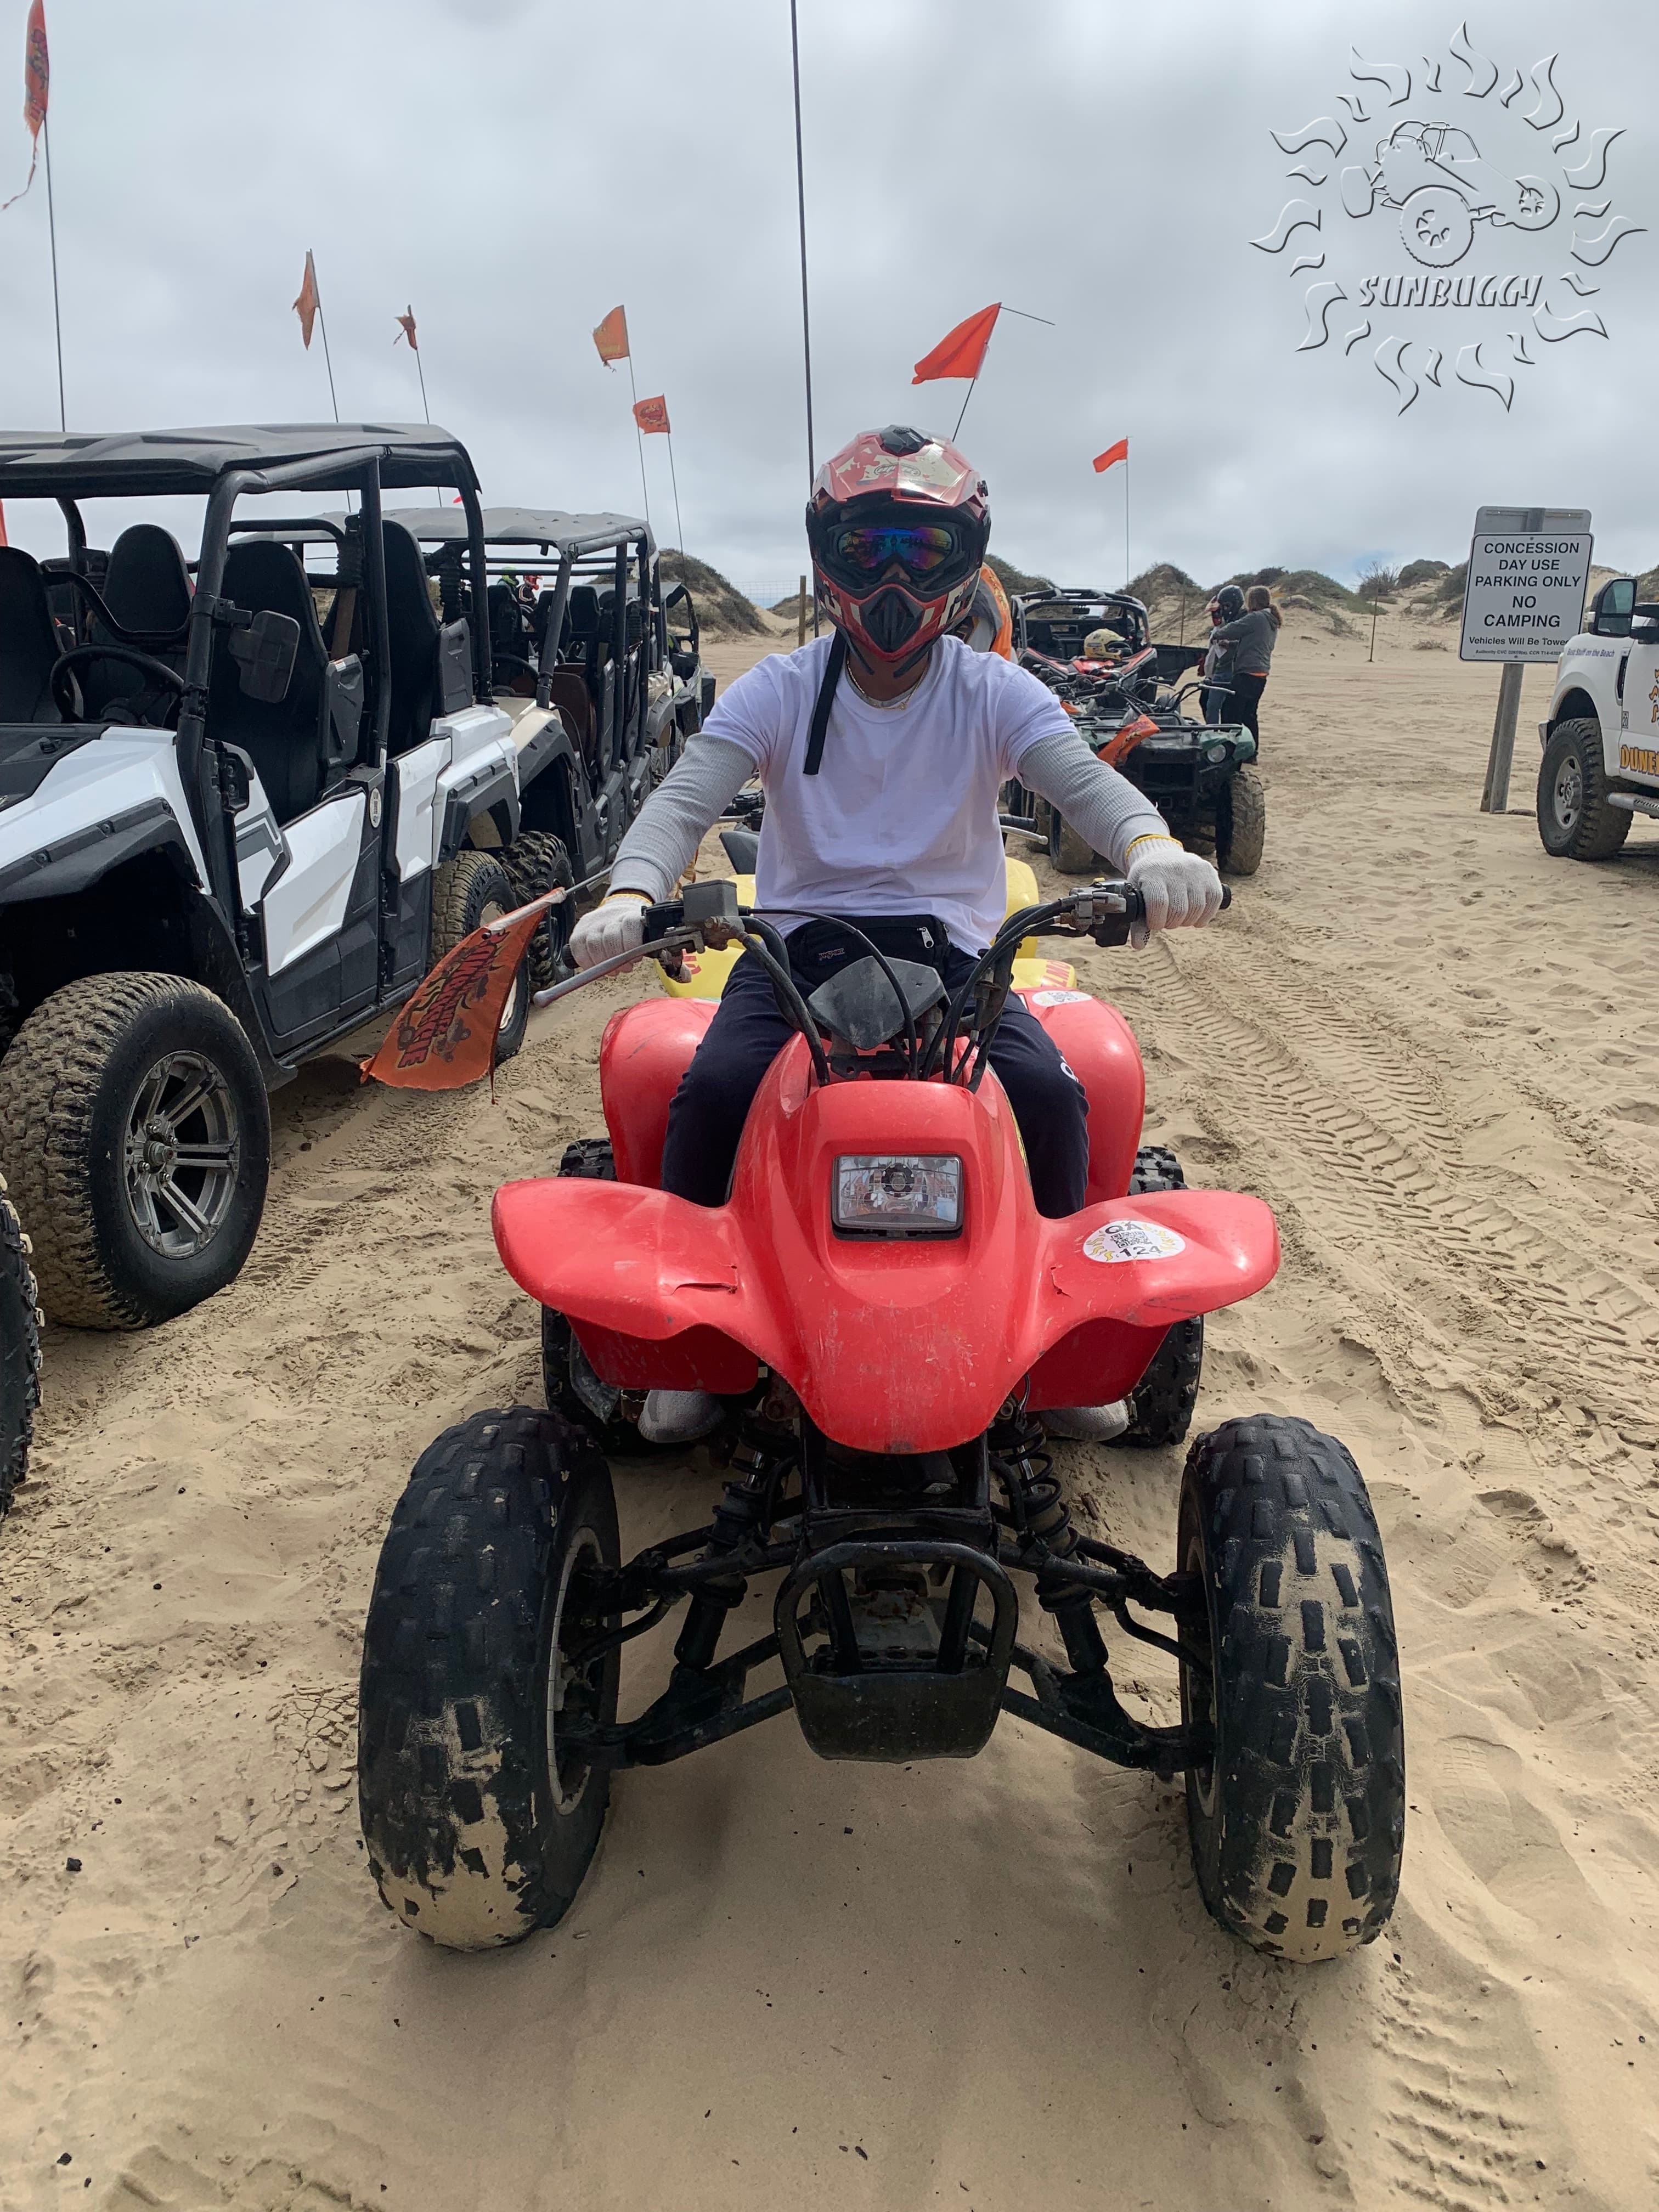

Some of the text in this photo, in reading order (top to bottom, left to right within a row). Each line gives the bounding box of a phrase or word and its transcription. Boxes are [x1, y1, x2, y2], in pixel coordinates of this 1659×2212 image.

[1483, 542, 1579, 554] CONCESSION
[1499, 559, 1560, 571] DAY USE
[1475, 575, 1581, 588] PARKING ONLY
[1512, 595, 1537, 608] NO
[1483, 614, 1561, 628] CAMPING
[1469, 636, 1505, 645] Vehicles
[1509, 637, 1524, 645] Will
[1527, 637, 1539, 646] Be
[1620, 744, 1659, 776] DUNE
[1120, 1245, 1163, 1257] 124
